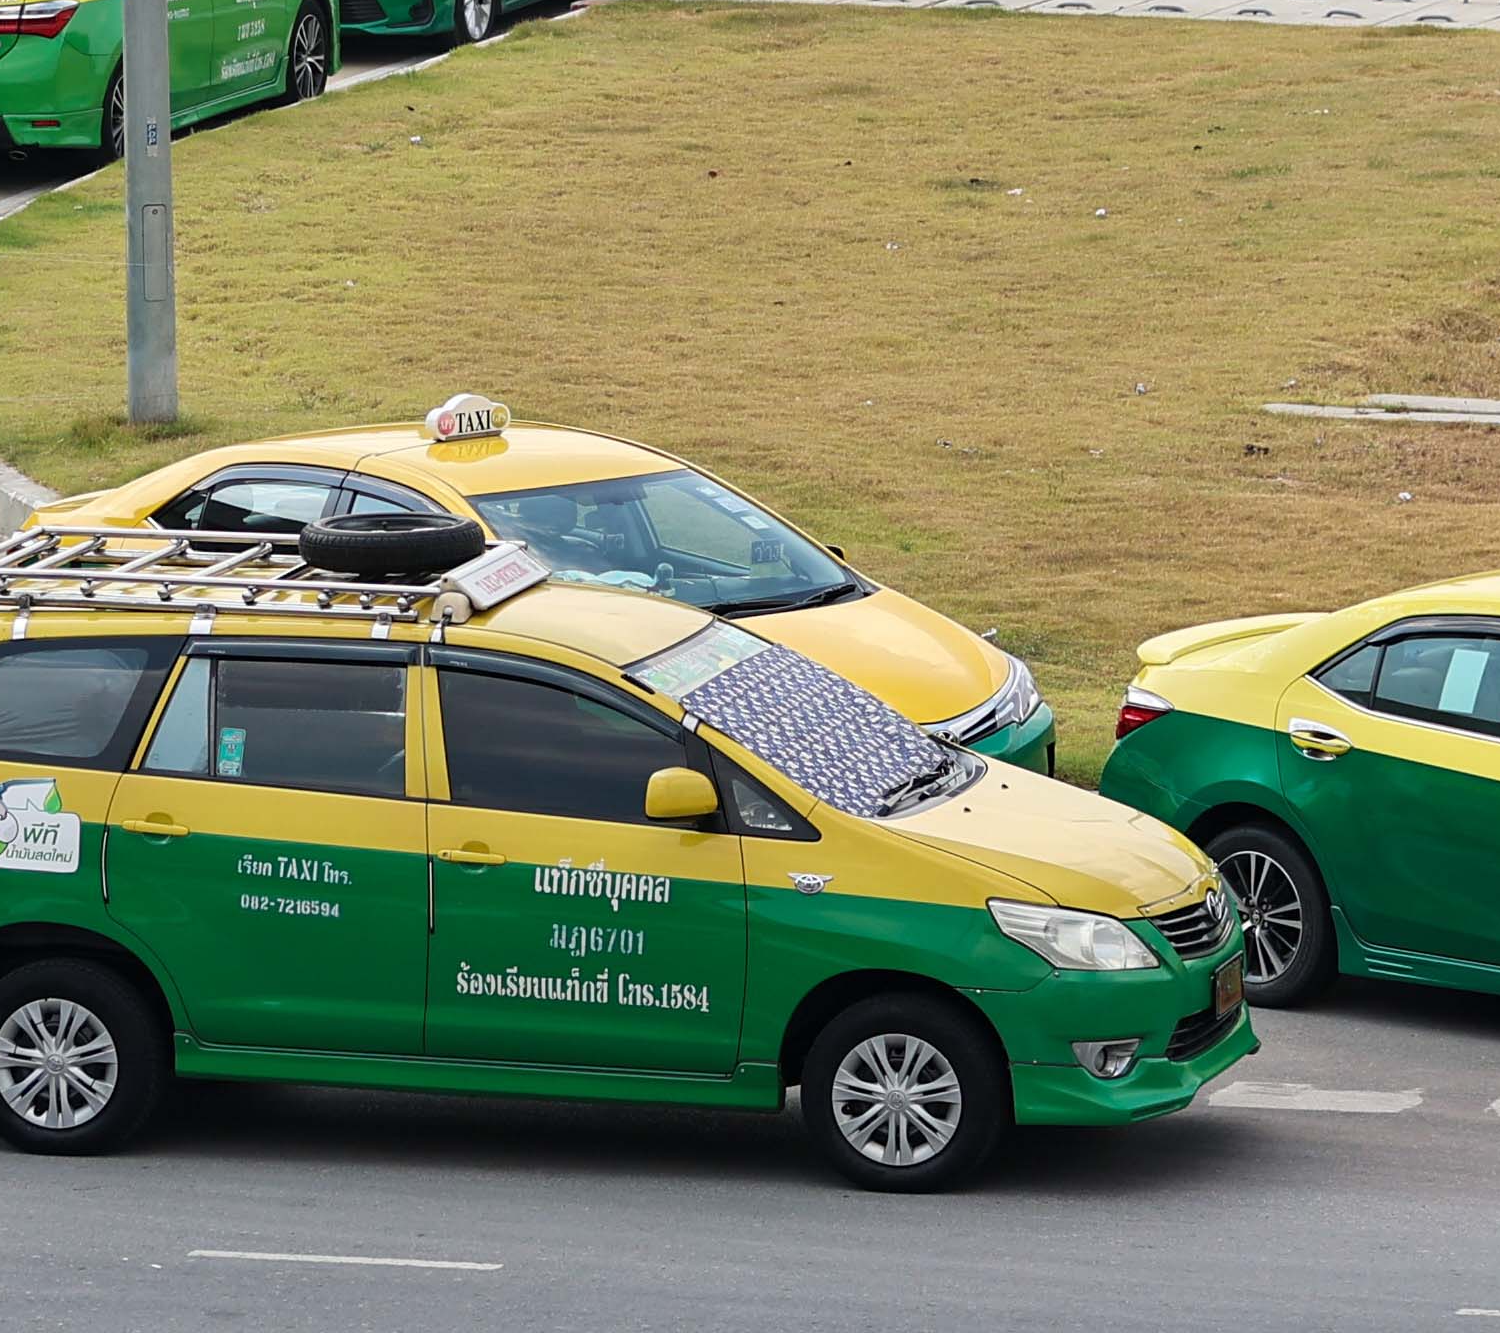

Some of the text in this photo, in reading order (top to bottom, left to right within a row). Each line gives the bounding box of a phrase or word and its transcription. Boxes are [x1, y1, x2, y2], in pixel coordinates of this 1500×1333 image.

[454, 409, 491, 435] TAXI
[23, 822, 62, 846] พีที
[5, 845, 74, 864] น้ำมันสดใหม่
[237, 854, 353, 886] เรียก TAXI โทร.
[534, 859, 671, 912] แท็กซี่บุคคล
[240, 893, 340, 918] 082-7216594
